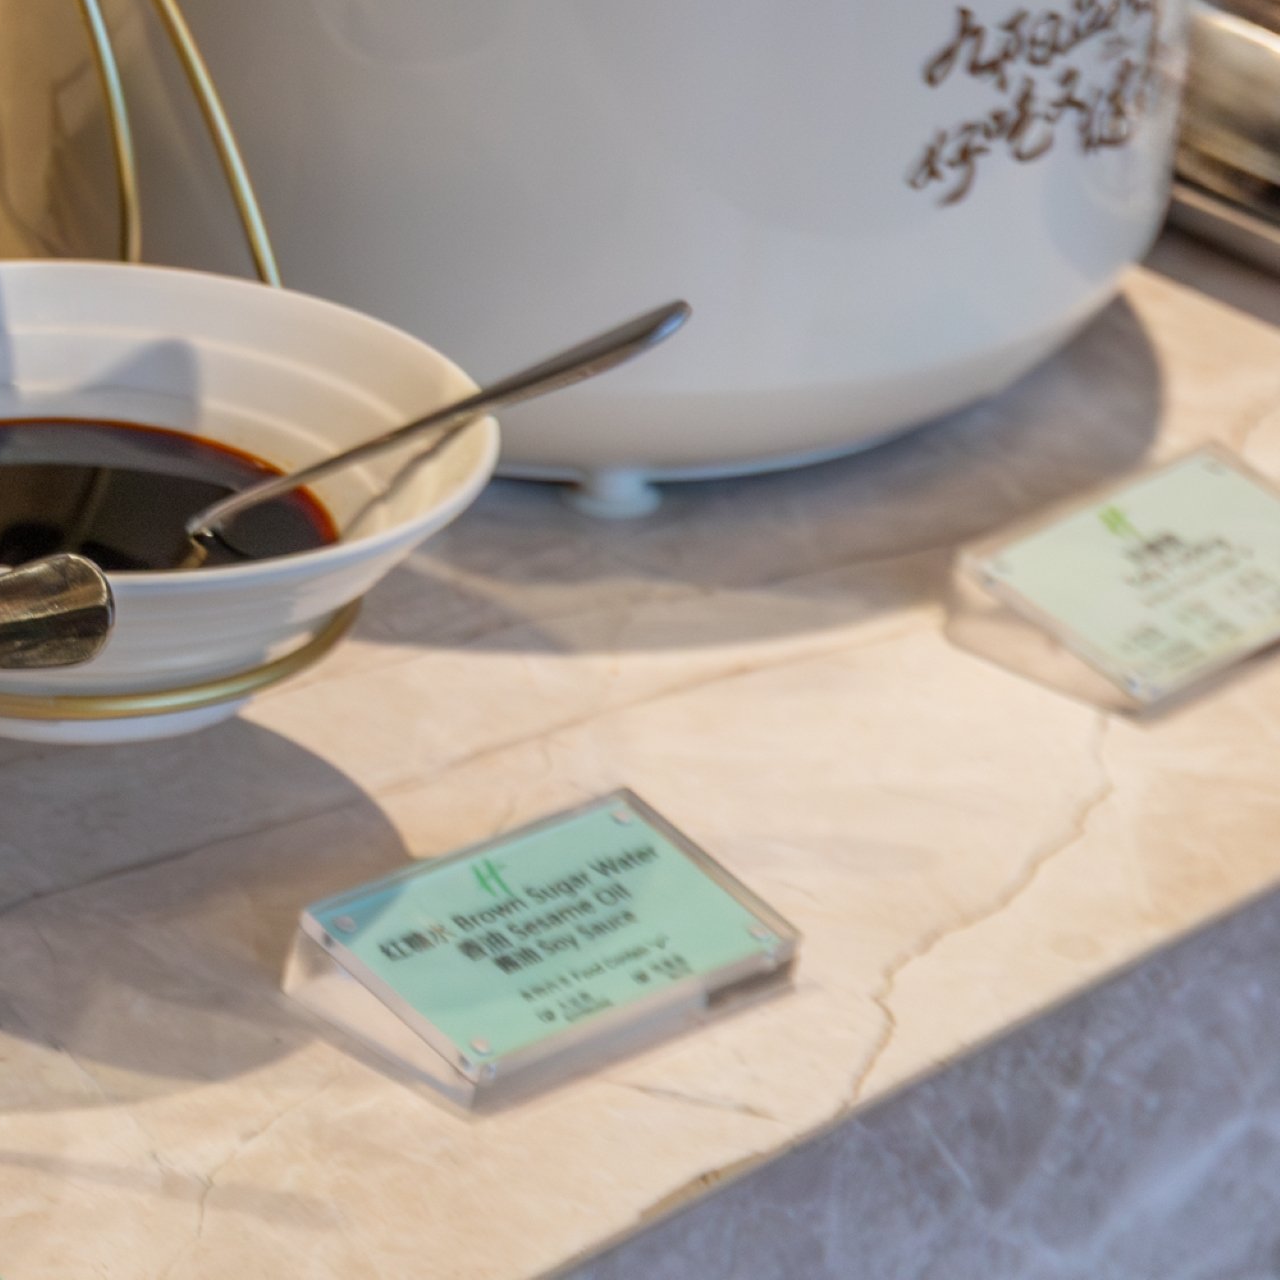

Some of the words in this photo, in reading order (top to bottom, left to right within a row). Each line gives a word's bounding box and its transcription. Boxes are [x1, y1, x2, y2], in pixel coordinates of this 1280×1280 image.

[451, 897, 529, 932] Brown
[523, 871, 593, 904] Sugar
[589, 844, 659, 877] Water
[506, 899, 596, 940] Sesame
[594, 882, 633, 907] Oil
[537, 933, 581, 957] Soy
[575, 909, 638, 941] Sauce
